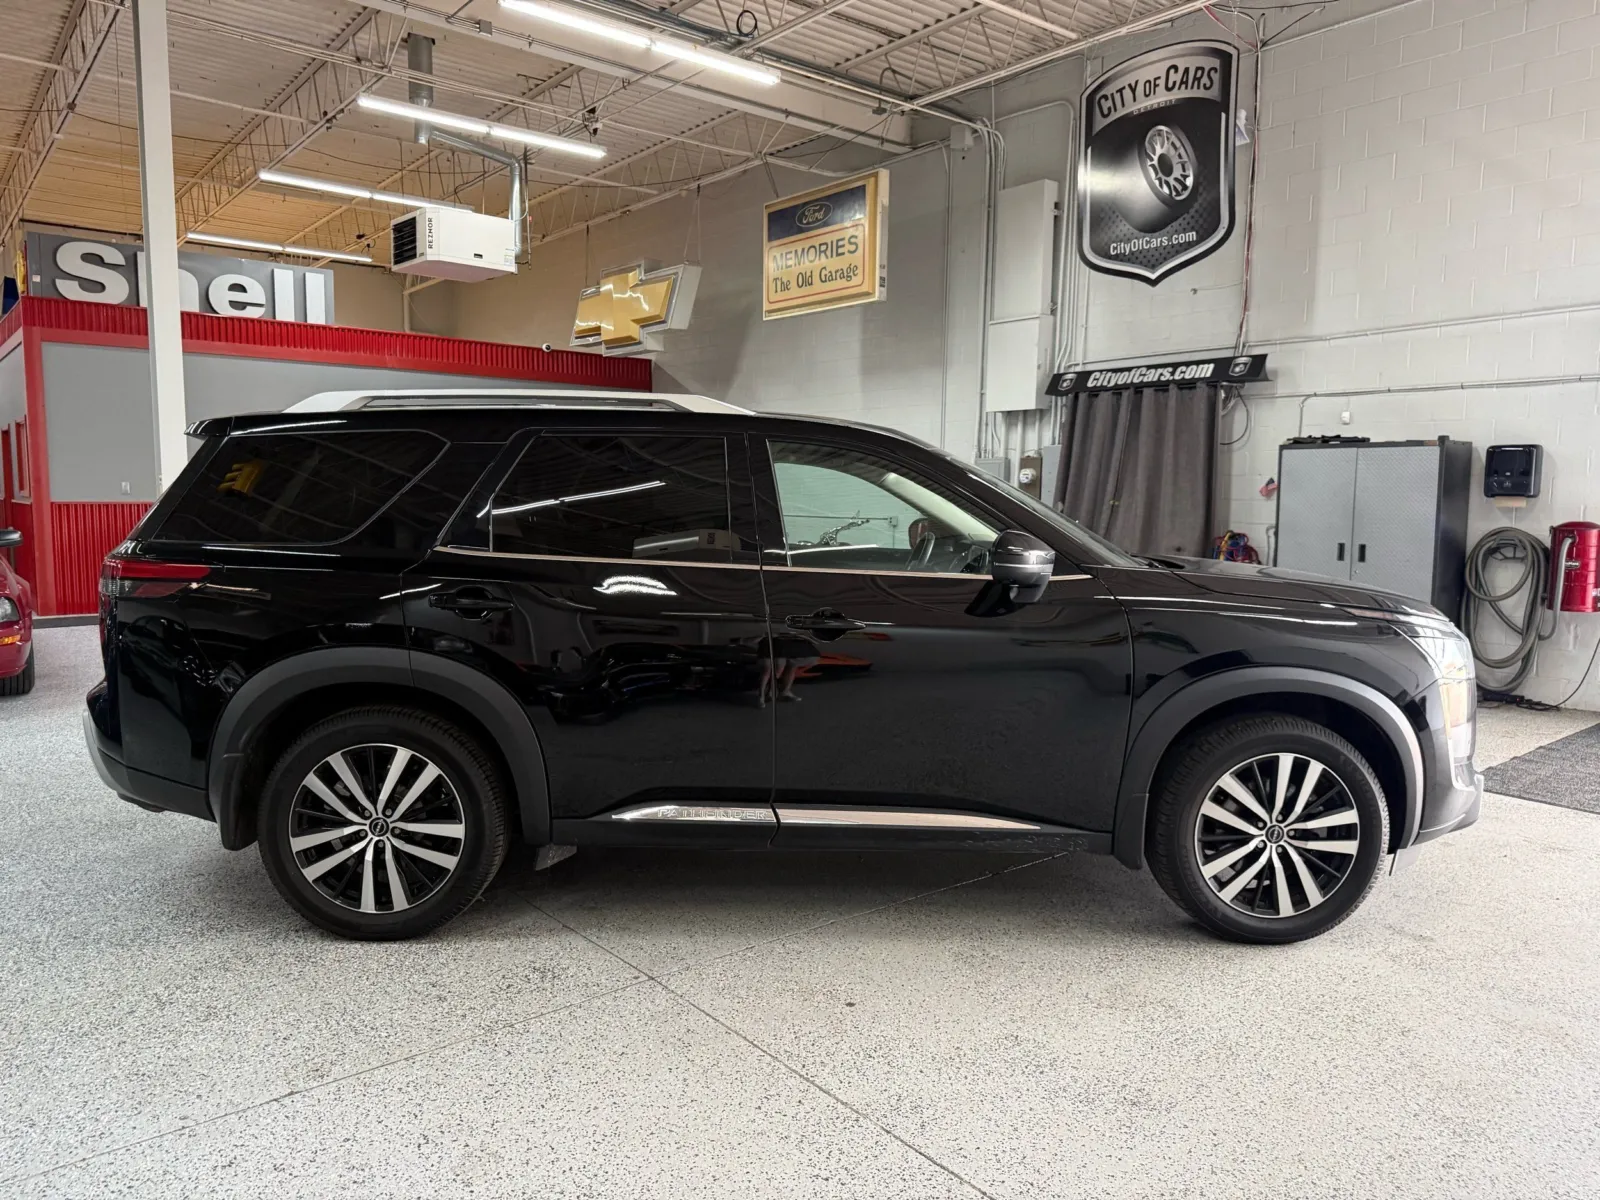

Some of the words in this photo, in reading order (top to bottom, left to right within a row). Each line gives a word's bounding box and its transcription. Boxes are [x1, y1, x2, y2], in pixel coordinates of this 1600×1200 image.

[1096, 79, 1139, 119] CITY
[1164, 64, 1218, 93] CARS
[1133, 99, 1176, 115] DETROIT
[802, 206, 825, 224] Ford
[772, 234, 859, 272] MEMORIES
[1110, 230, 1197, 256] CityOfCars.com
[772, 276, 791, 294] The
[796, 270, 813, 289] Old
[819, 263, 858, 282] Garage
[1086, 362, 1215, 388] CityofCars.com
[657, 808, 767, 820] PATHFINDER
